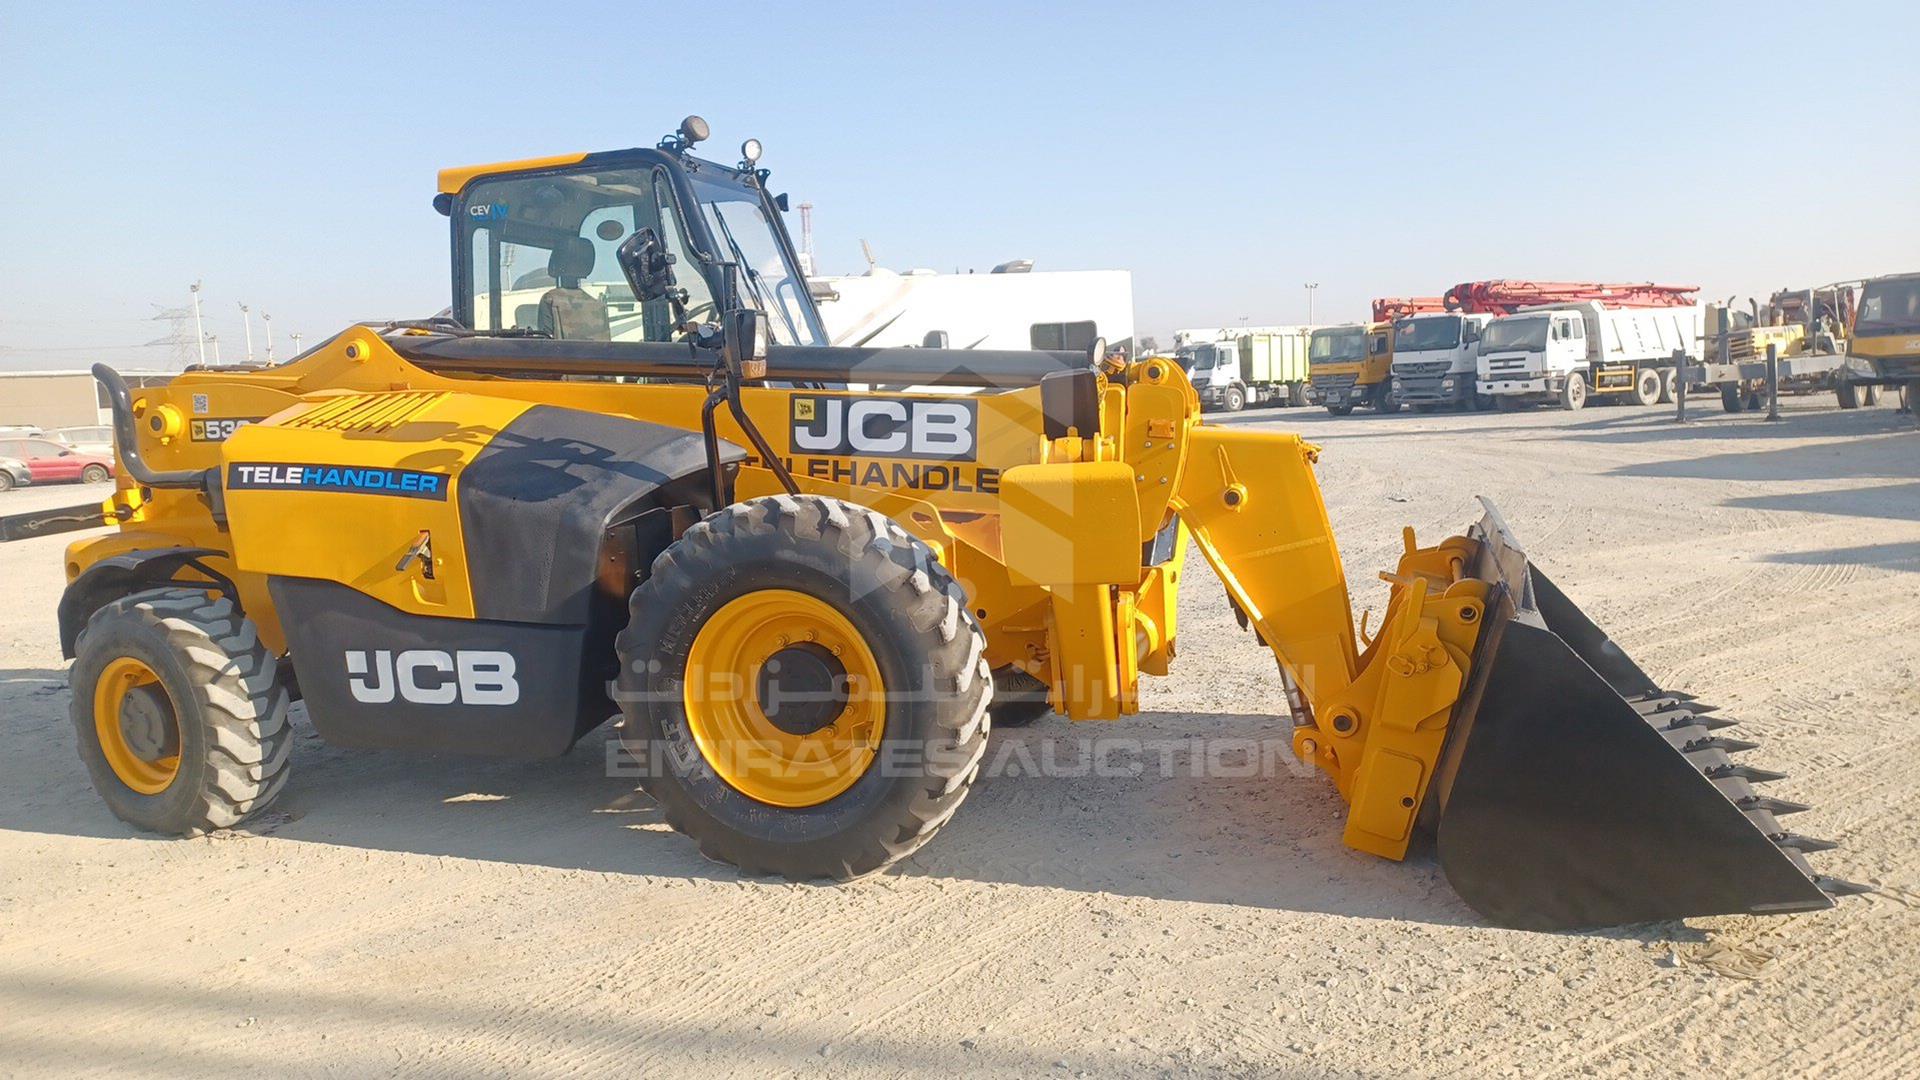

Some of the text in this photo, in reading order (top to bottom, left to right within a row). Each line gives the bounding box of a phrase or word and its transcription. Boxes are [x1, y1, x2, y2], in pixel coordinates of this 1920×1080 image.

[470, 204, 491, 216] CEV
[205, 420, 250, 439] 53
[794, 398, 972, 455] JCB
[238, 466, 438, 493] TELEHANDLER
[744, 456, 1000, 494] EHANDLE
[345, 650, 519, 705] JCB
